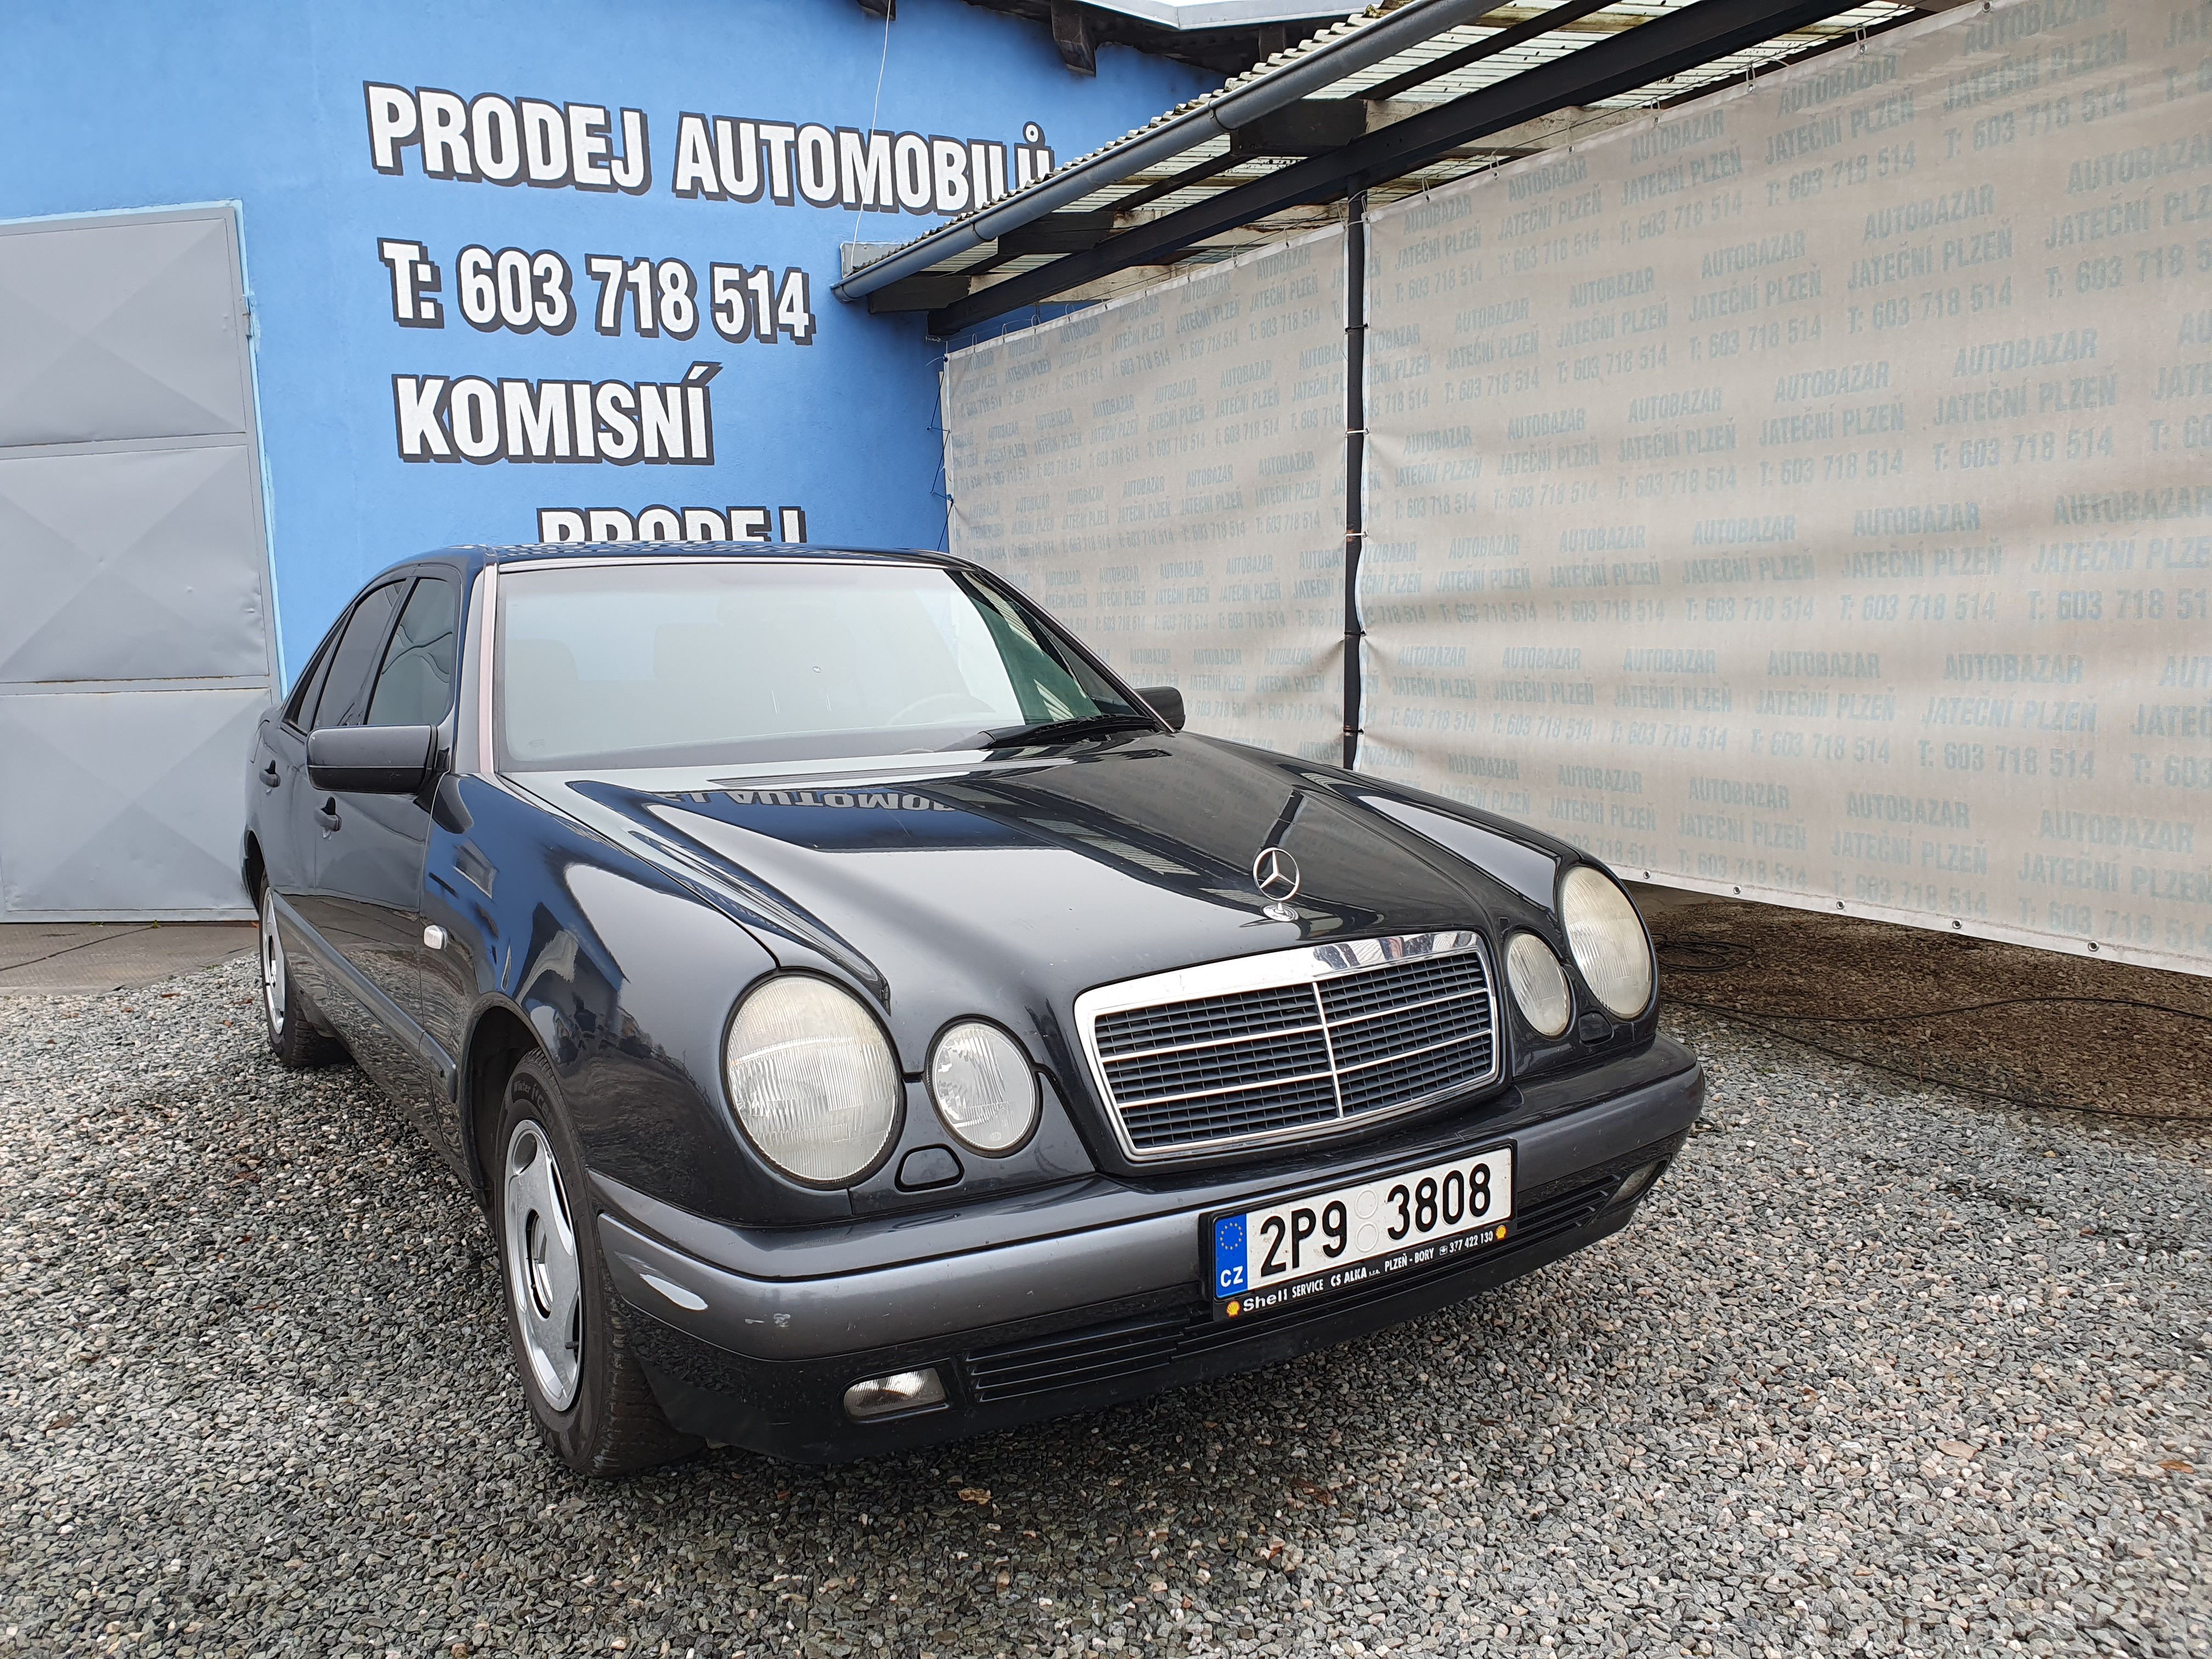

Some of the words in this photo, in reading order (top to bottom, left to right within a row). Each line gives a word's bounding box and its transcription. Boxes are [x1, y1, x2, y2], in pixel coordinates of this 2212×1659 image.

[362, 80, 652, 196] PRODEJ
[672, 112, 1054, 217] AUTOMOBILŮ
[1630, 109, 1725, 163] AUTOBAZAR
[1638, 210, 1666, 239] 603
[1675, 201, 1703, 230] 718
[1711, 189, 1742, 221] 514
[1864, 184, 1995, 245] AUTOBAZAR
[1256, 247, 1311, 281] AUTOBAZAR
[1702, 229, 1805, 279] AUTOBAZAR
[377, 237, 443, 329] T:
[457, 245, 576, 336] 603
[586, 253, 696, 342] 718
[709, 262, 816, 345] 514
[1181, 273, 1231, 304] AUTOBAZAR
[1569, 266, 1655, 309] AUTOBAZAR
[1872, 297, 1910, 329] 603
[1921, 286, 1961, 320] 718
[1970, 276, 2013, 313] 514
[1261, 317, 1277, 338] 603
[1282, 312, 1297, 333] 718
[1303, 306, 1321, 327] 514
[1709, 330, 1740, 358] 603
[1747, 321, 1780, 351] 718
[1788, 314, 1821, 345] 514
[1190, 338, 1204, 358] 603
[1207, 333, 1221, 353] 718
[1224, 328, 1238, 348] 514
[1952, 329, 2097, 377] AUTOBAZAR
[1221, 360, 1271, 388] AUTOBAZAR
[1574, 356, 1599, 381] 603
[1606, 350, 1633, 375] 718
[1640, 342, 1667, 369] 514
[1774, 361, 1889, 403] AUTOBAZAR
[392, 362, 722, 466] KOMISNÍ
[1628, 387, 1723, 422] AUTOBAZAR
[1224, 425, 1239, 444] 603
[1243, 421, 1260, 441] 718
[1264, 417, 1279, 436] 514
[1508, 408, 1585, 439] AUTOBAZAR
[1259, 451, 1315, 477] AUTOBAZAR
[1959, 439, 2000, 469] 603
[2012, 432, 2055, 465] 718
[2067, 426, 2113, 460] 514
[1636, 474, 1664, 498] 603
[1671, 469, 1699, 494] 718
[1706, 466, 1737, 491] 514
[1781, 458, 1814, 485] 603
[1824, 452, 1858, 482] 718
[1866, 448, 1904, 478] 514
[1509, 486, 1533, 508] 603
[1541, 483, 1565, 505] 718
[1571, 481, 1598, 503] 514
[1266, 515, 1281, 533] 603
[1285, 512, 1299, 531] 718
[1304, 510, 1320, 529] 514
[1853, 501, 1981, 536] AUTOBAZAR
[1862, 594, 1899, 621] 603
[1908, 592, 1946, 620] 718
[1955, 591, 1997, 620] 514
[1502, 647, 1581, 670] AUTOBAZAR
[1623, 649, 1716, 673] AUTOBAZAR
[1943, 653, 2084, 684] AUTOBAZAR
[1507, 714, 1532, 735] 603
[1537, 716, 1561, 738] 718
[1566, 718, 1593, 740] 514
[1629, 721, 1656, 746] 603
[1663, 724, 1691, 748] 718
[1697, 726, 1728, 751] 514
[1944, 742, 1984, 771] 603
[1995, 744, 2037, 775] 718
[2050, 748, 2095, 781] 514
[1847, 792, 1970, 828] AUTOBAZAR
[1856, 873, 1891, 904] 603
[1900, 880, 1938, 910] 718
[1949, 887, 1988, 918] 514
[1260, 1200, 1347, 1278] 2P9
[1387, 1162, 1491, 1241] 3808
[1221, 1266, 1243, 1287] CZ
[1243, 1289, 1287, 1312] Shell
[1292, 1278, 1323, 1298] SERVICE
[1330, 1274, 1341, 1286] CS
[1344, 1267, 1367, 1284] ALKA
[1385, 1253, 1407, 1272] PLZEŇ
[1414, 1248, 1434, 1263] BORY
[1449, 1239, 1463, 1252] 377
[1464, 1235, 1478, 1248] 422
[1481, 1231, 1493, 1244] 130
